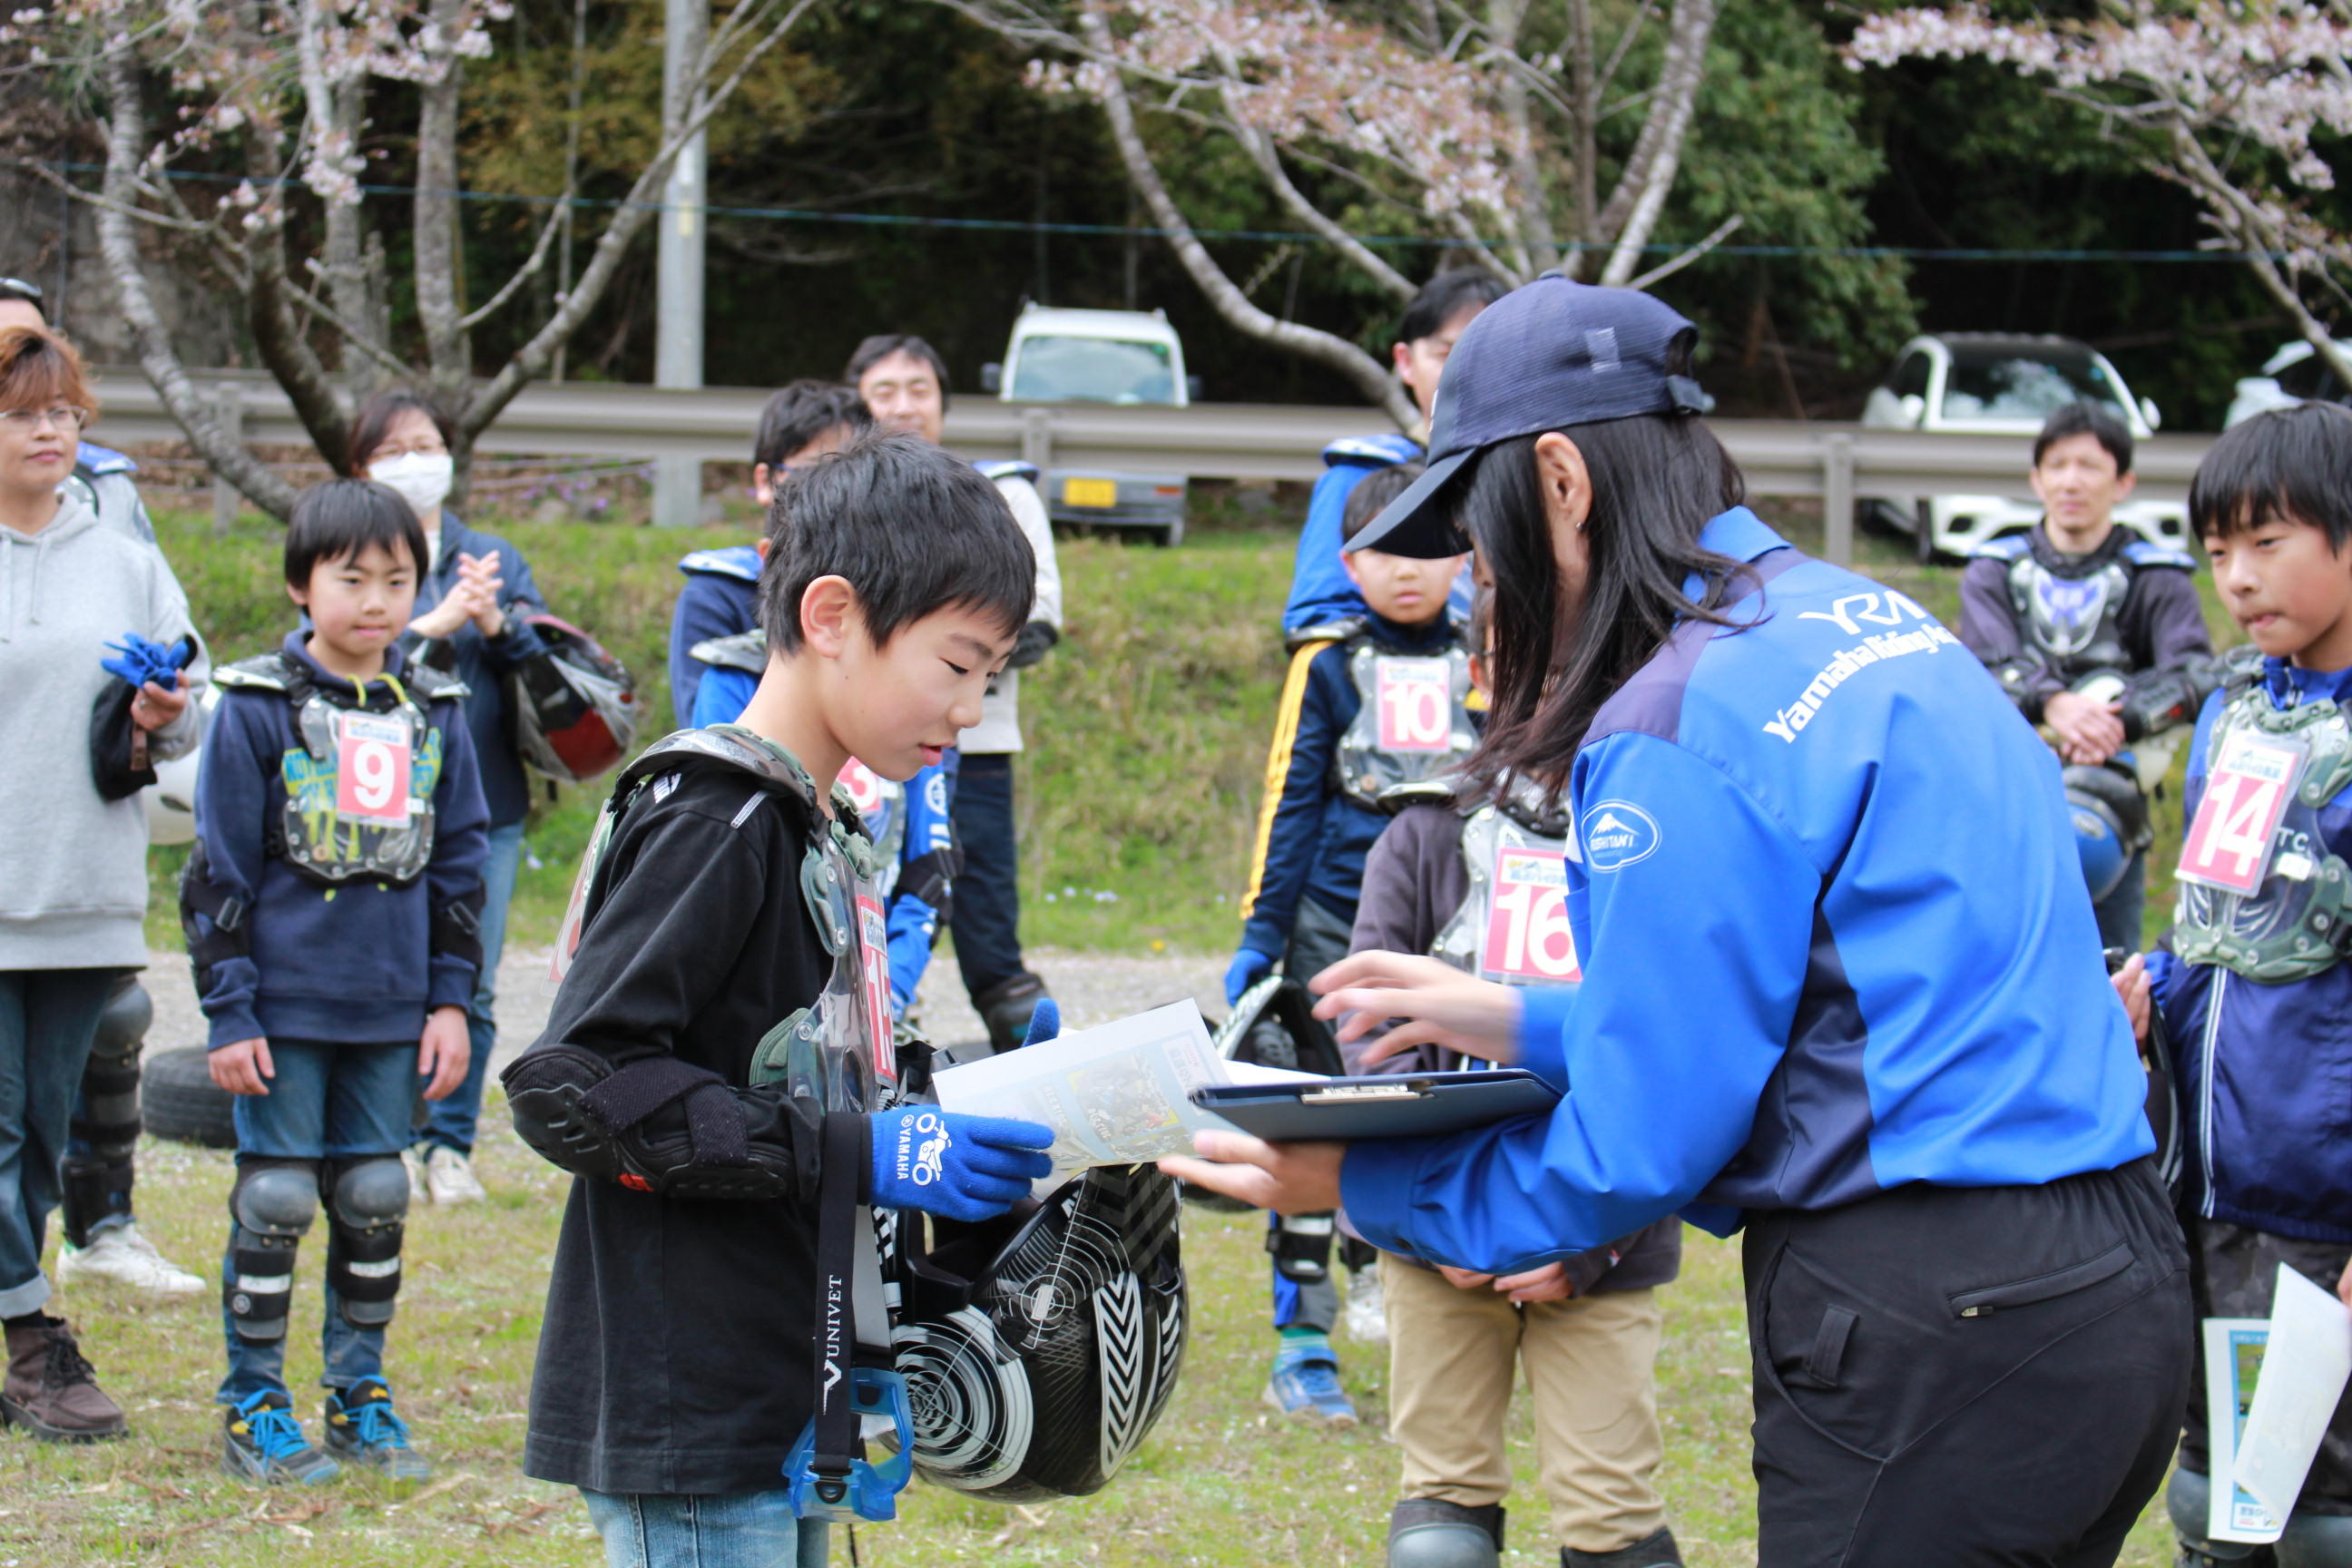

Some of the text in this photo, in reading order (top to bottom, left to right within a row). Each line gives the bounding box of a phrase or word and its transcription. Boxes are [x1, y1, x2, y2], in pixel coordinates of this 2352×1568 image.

[1384, 682, 1449, 743] 10
[1762, 644, 1879, 744] Yamaha
[353, 741, 396, 809] 9
[2197, 775, 2279, 877] 14
[1495, 884, 1579, 975] 16
[897, 1127, 912, 1180] YAMAHA
[827, 1274, 842, 1358] UNIVET
